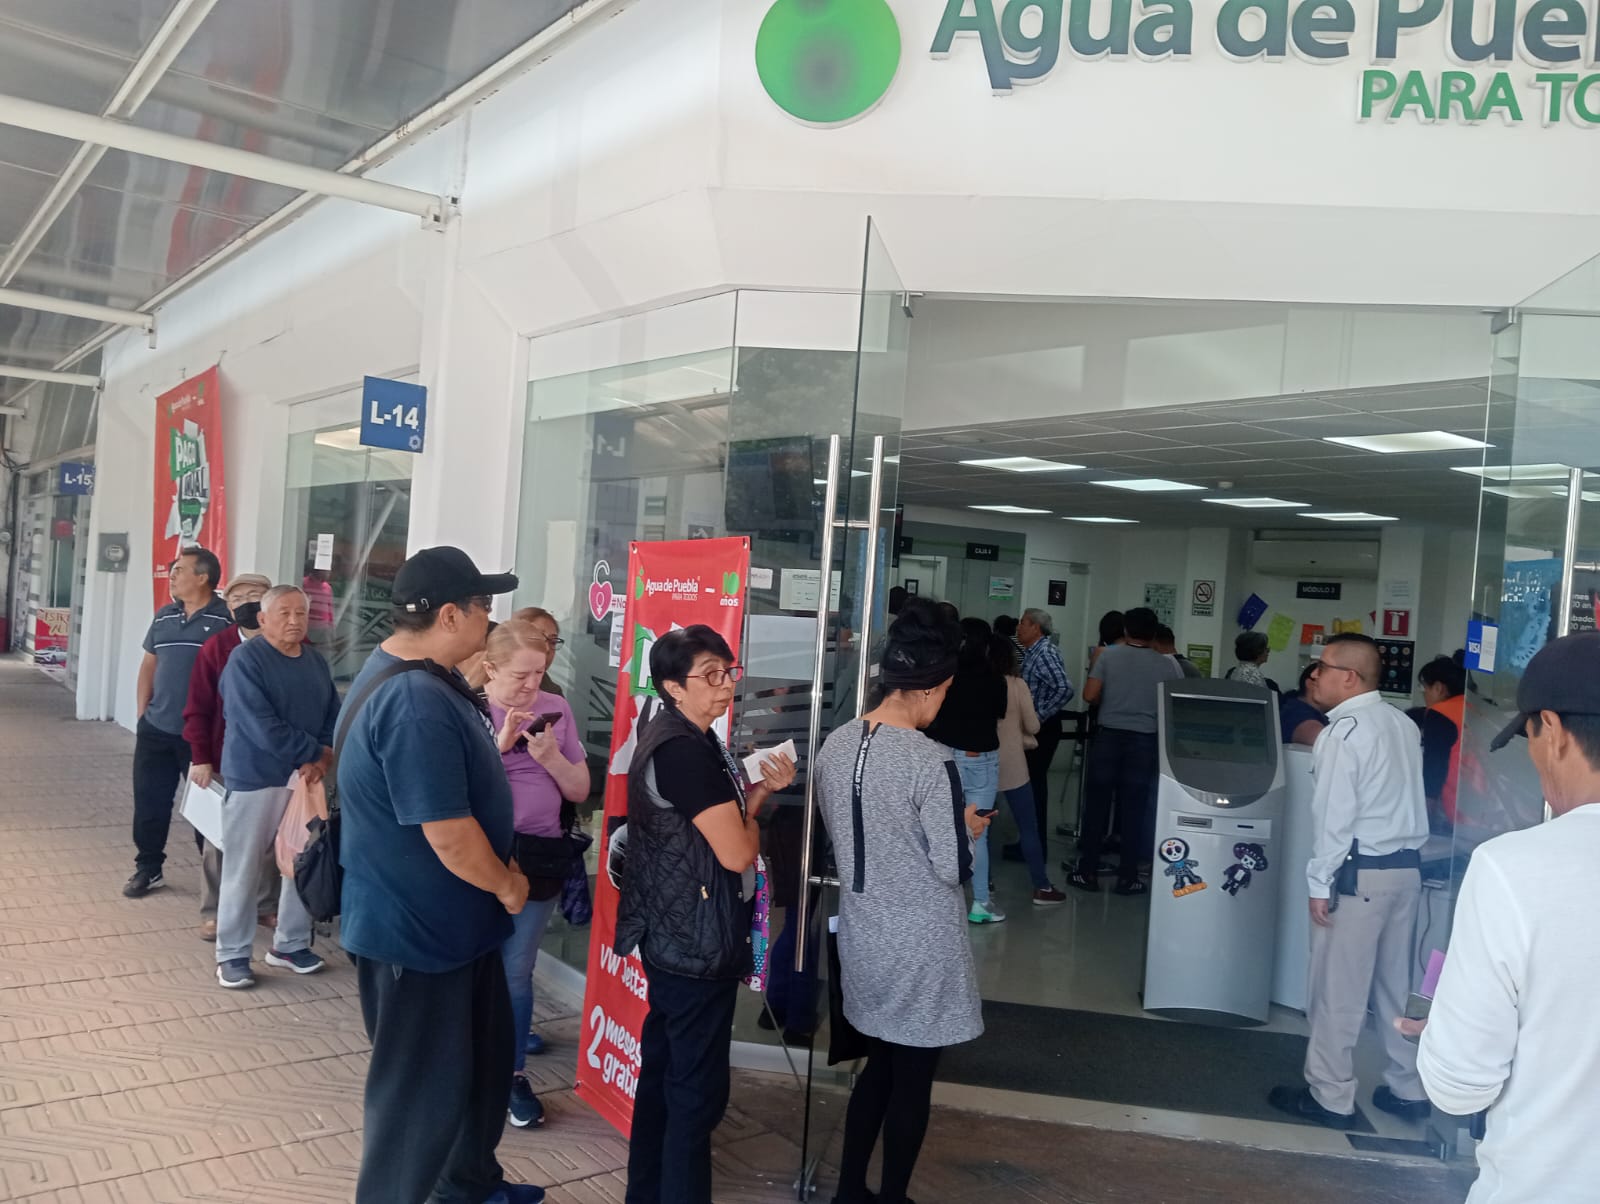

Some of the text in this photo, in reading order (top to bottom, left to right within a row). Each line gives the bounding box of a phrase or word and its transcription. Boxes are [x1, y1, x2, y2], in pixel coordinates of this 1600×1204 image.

[929, 0, 1600, 90] Agua de Pue
[1361, 69, 1524, 121] PARA
[370, 400, 419, 430] L-14
[65, 472, 93, 485] L-15
[645, 578, 699, 597] Agua de Puebla
[600, 943, 621, 977] VW
[621, 956, 648, 1002] Jetta
[586, 1005, 606, 1069] 2
[605, 1015, 642, 1068] meses
